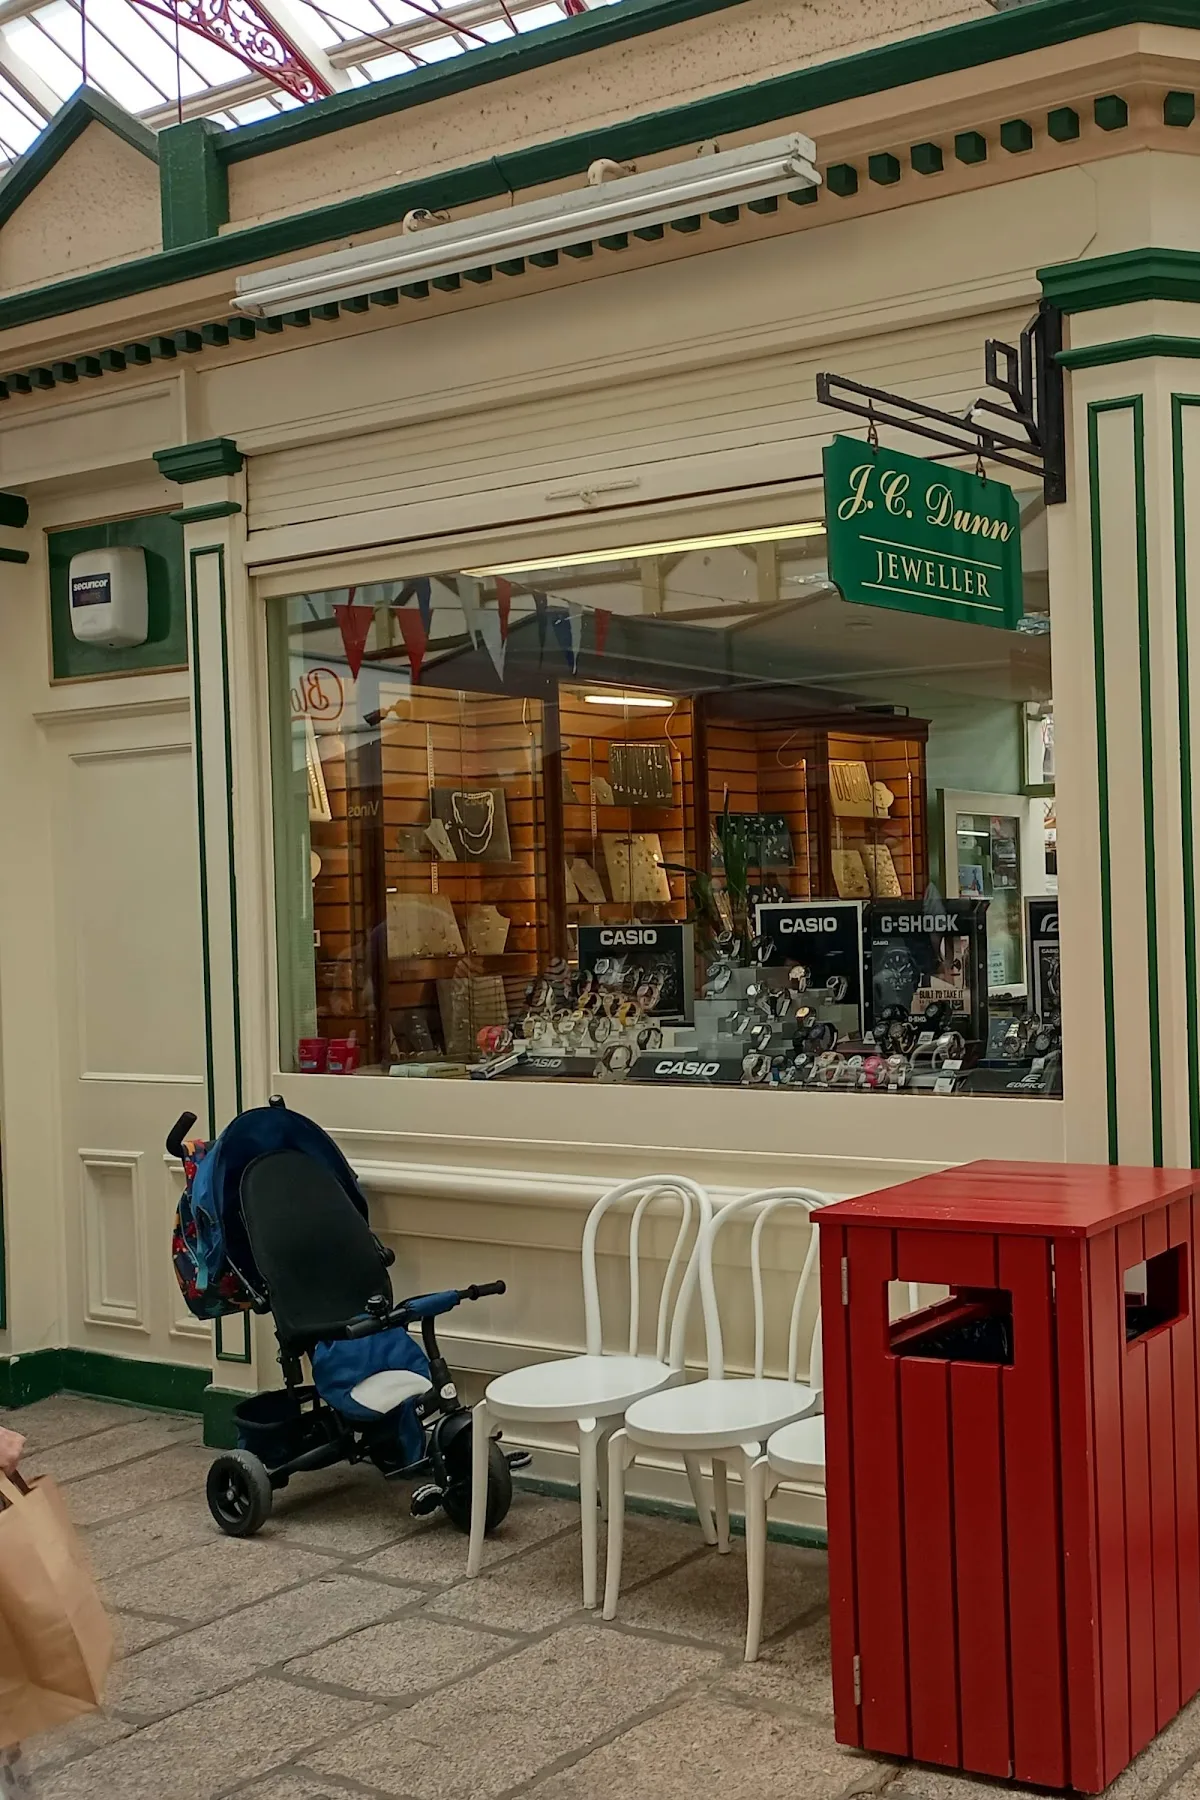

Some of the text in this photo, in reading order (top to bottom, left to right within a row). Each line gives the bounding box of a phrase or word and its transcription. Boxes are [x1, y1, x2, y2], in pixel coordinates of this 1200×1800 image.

[925, 483, 1015, 542] Dunn
[876, 550, 991, 598] JEWELLER
[779, 916, 838, 934] CASIO
[881, 913, 959, 933] G-SHOCK
[599, 929, 658, 946] CASIO
[654, 1060, 720, 1076] CASIO
